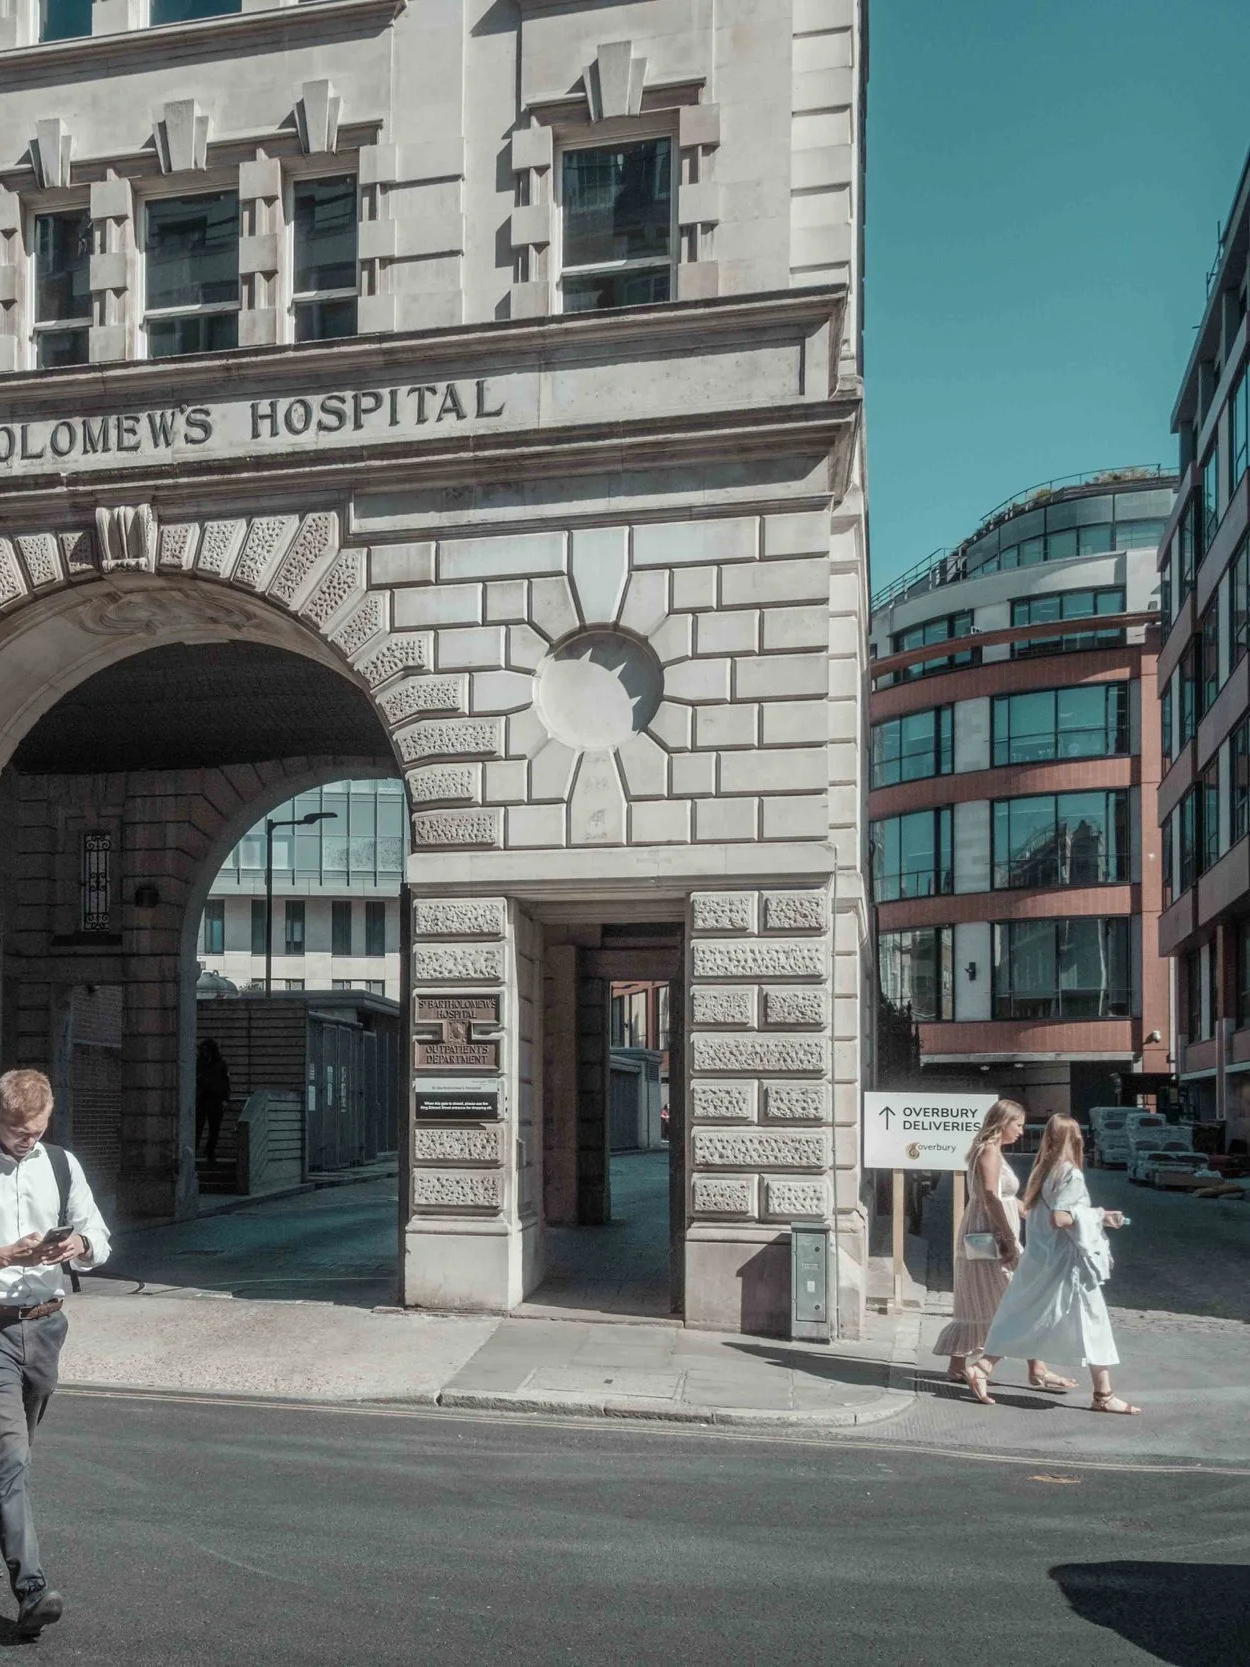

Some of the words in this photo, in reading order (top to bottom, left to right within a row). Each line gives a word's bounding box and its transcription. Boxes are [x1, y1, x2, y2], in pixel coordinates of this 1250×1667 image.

[250, 379, 506, 440] HOSPITAL
[437, 1010, 478, 1019] HOSPITAL
[426, 1045, 488, 1054] OUTPATIENTS
[426, 1055, 488, 1064] DEPARTMENT
[903, 1107, 978, 1118] OVERBURY
[903, 1120, 981, 1132] DELIVERIES
[918, 1142, 956, 1154] overbury
